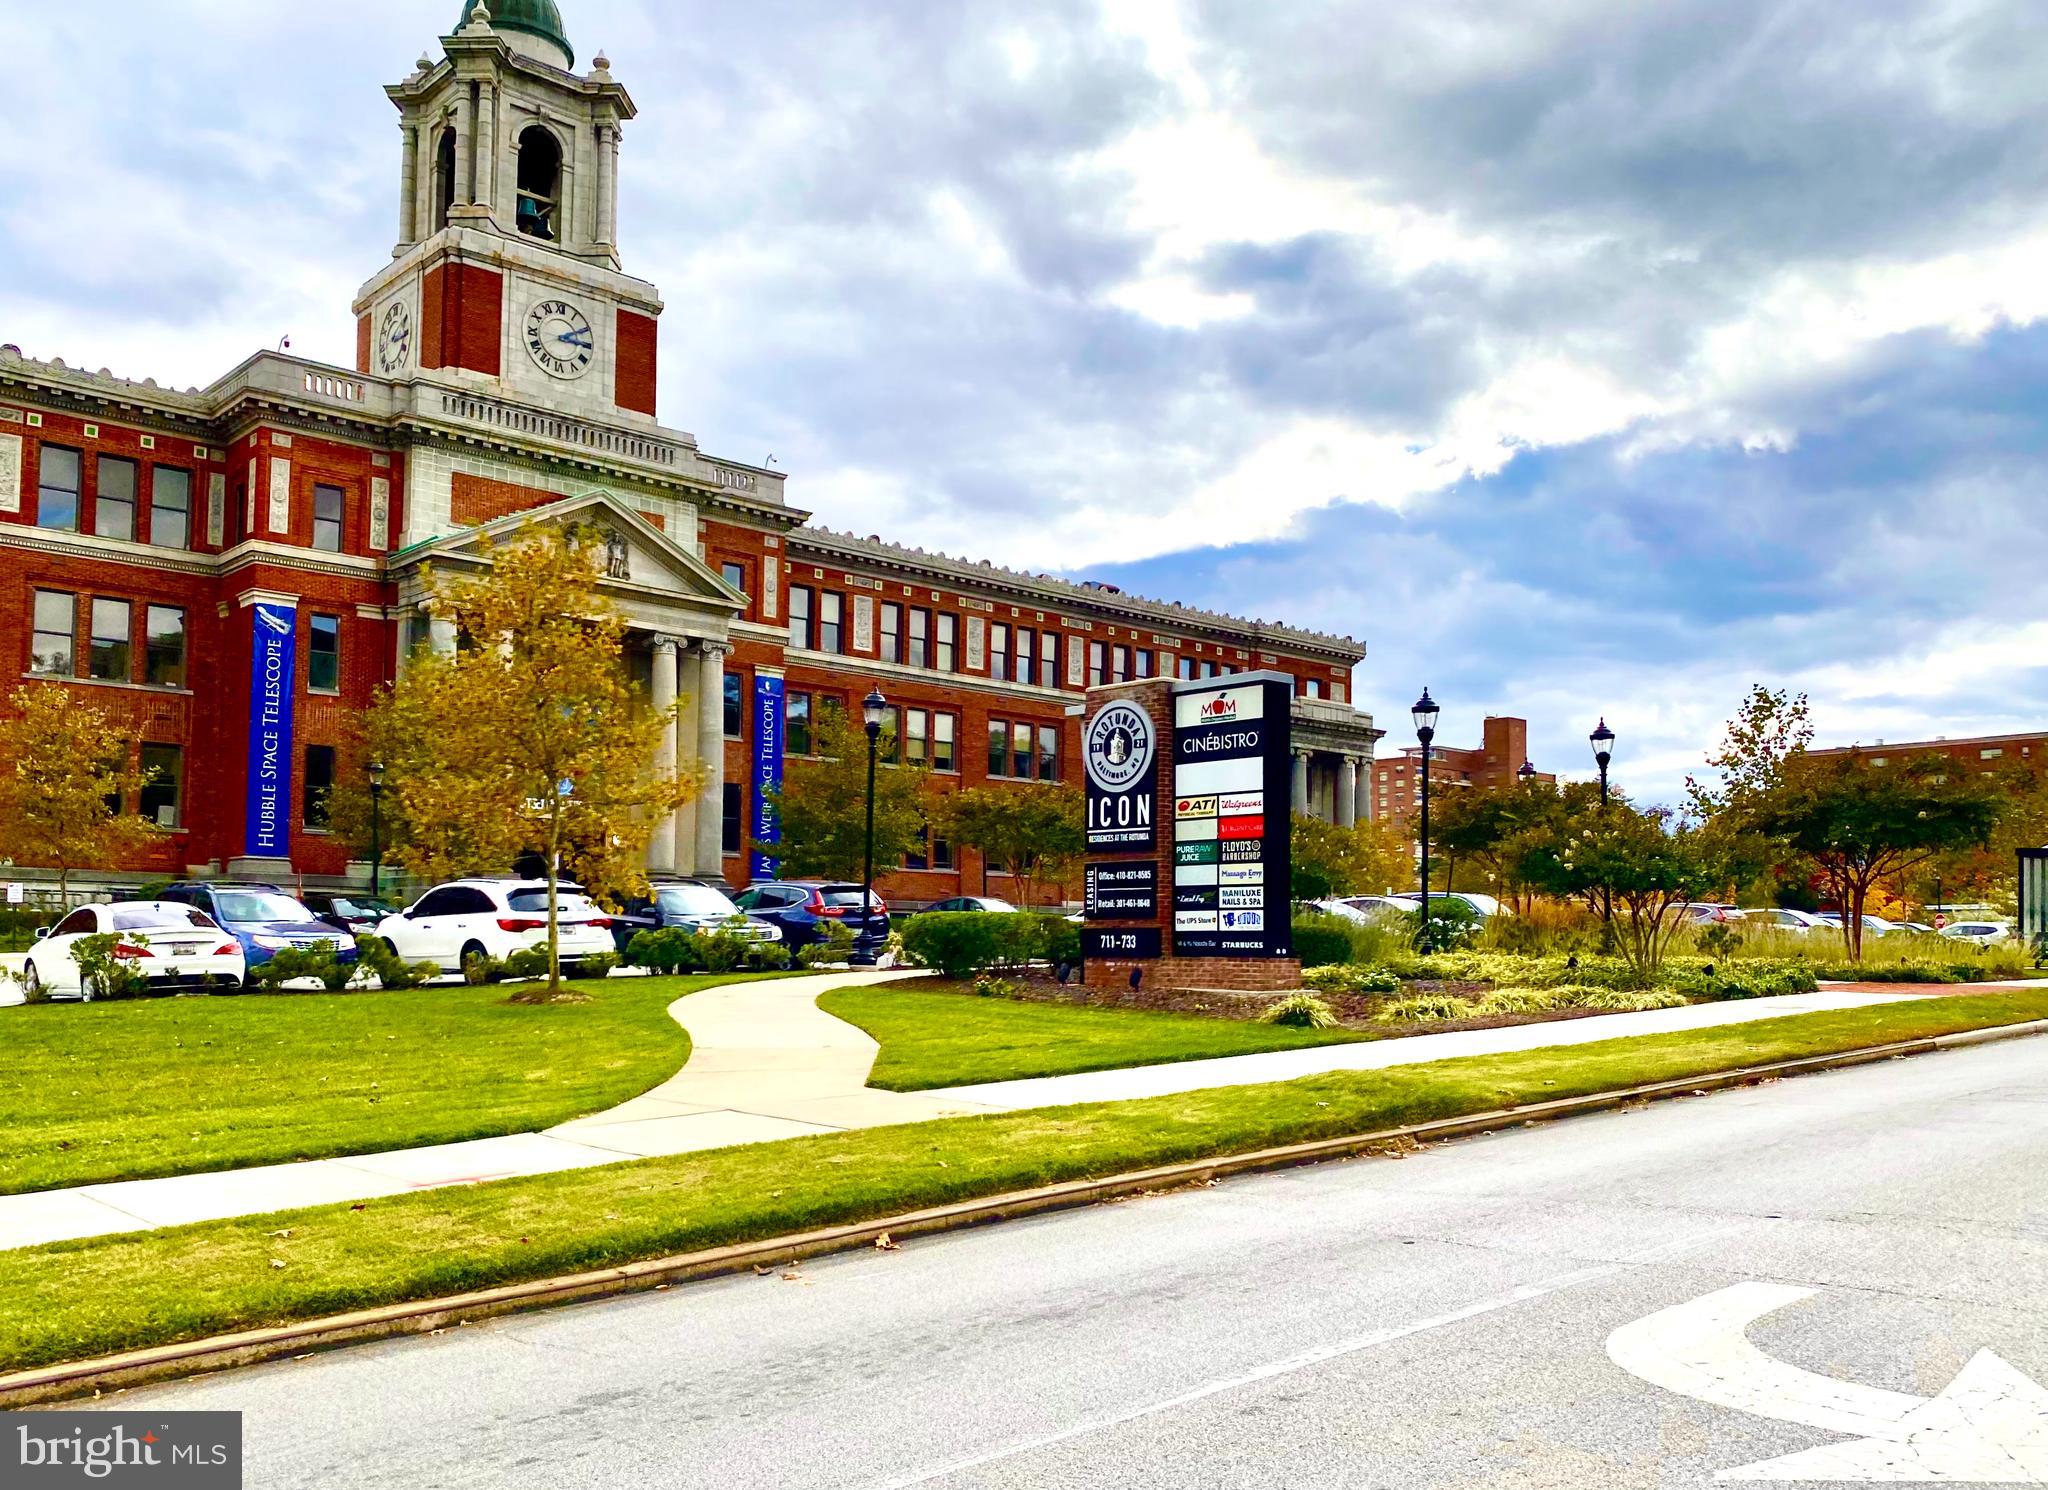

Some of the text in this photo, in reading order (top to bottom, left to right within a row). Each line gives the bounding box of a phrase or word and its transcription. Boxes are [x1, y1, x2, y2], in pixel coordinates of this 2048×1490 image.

[761, 698, 774, 760] TELESCOPE
[1096, 713, 1141, 739] ROTUNDA
[258, 638, 282, 847] HUBBLE SPACE TELESCOPE
[1183, 731, 1259, 753] CINÉBISTRO
[1088, 794, 1150, 827] ICON
[1190, 799, 1216, 811] ATI
[1221, 800, 1262, 811] Walgreens
[1120, 833, 1128, 841] THE
[1222, 841, 1251, 852] FLOYD'S
[760, 839, 772, 873] JAS
[1181, 853, 1199, 861] JUICE
[1222, 851, 1260, 861] BARBERSHOP
[1222, 889, 1261, 897] MANILUXE
[1222, 898, 1240, 906] NAILS
[1100, 935, 1136, 948] 711-733
